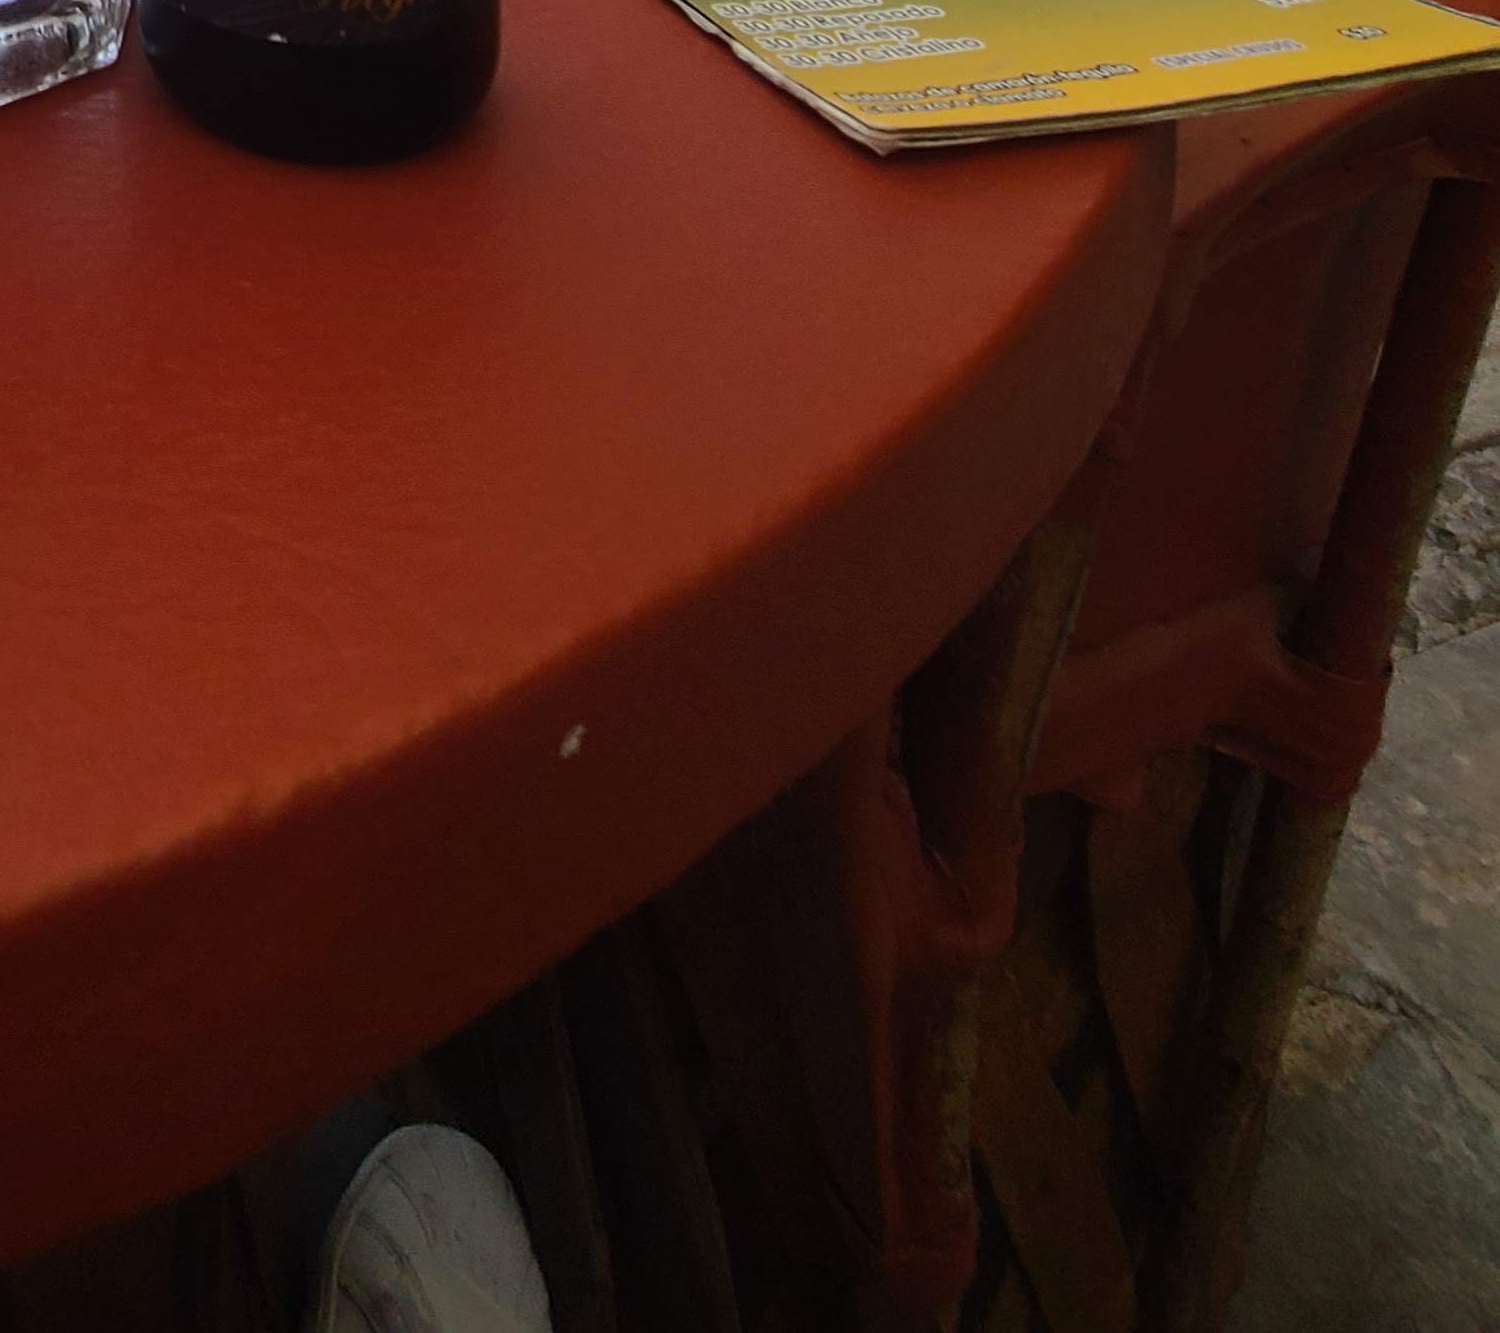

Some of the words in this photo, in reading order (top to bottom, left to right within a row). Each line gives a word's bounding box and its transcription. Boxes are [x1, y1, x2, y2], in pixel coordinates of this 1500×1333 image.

[711, 0, 792, 17] 30-30
[733, 15, 813, 34] 30-30
[809, 4, 944, 28] Reposado
[755, 31, 838, 50] 30-30
[778, 48, 860, 67] 30-30
[855, 38, 982, 59] Cristalino
